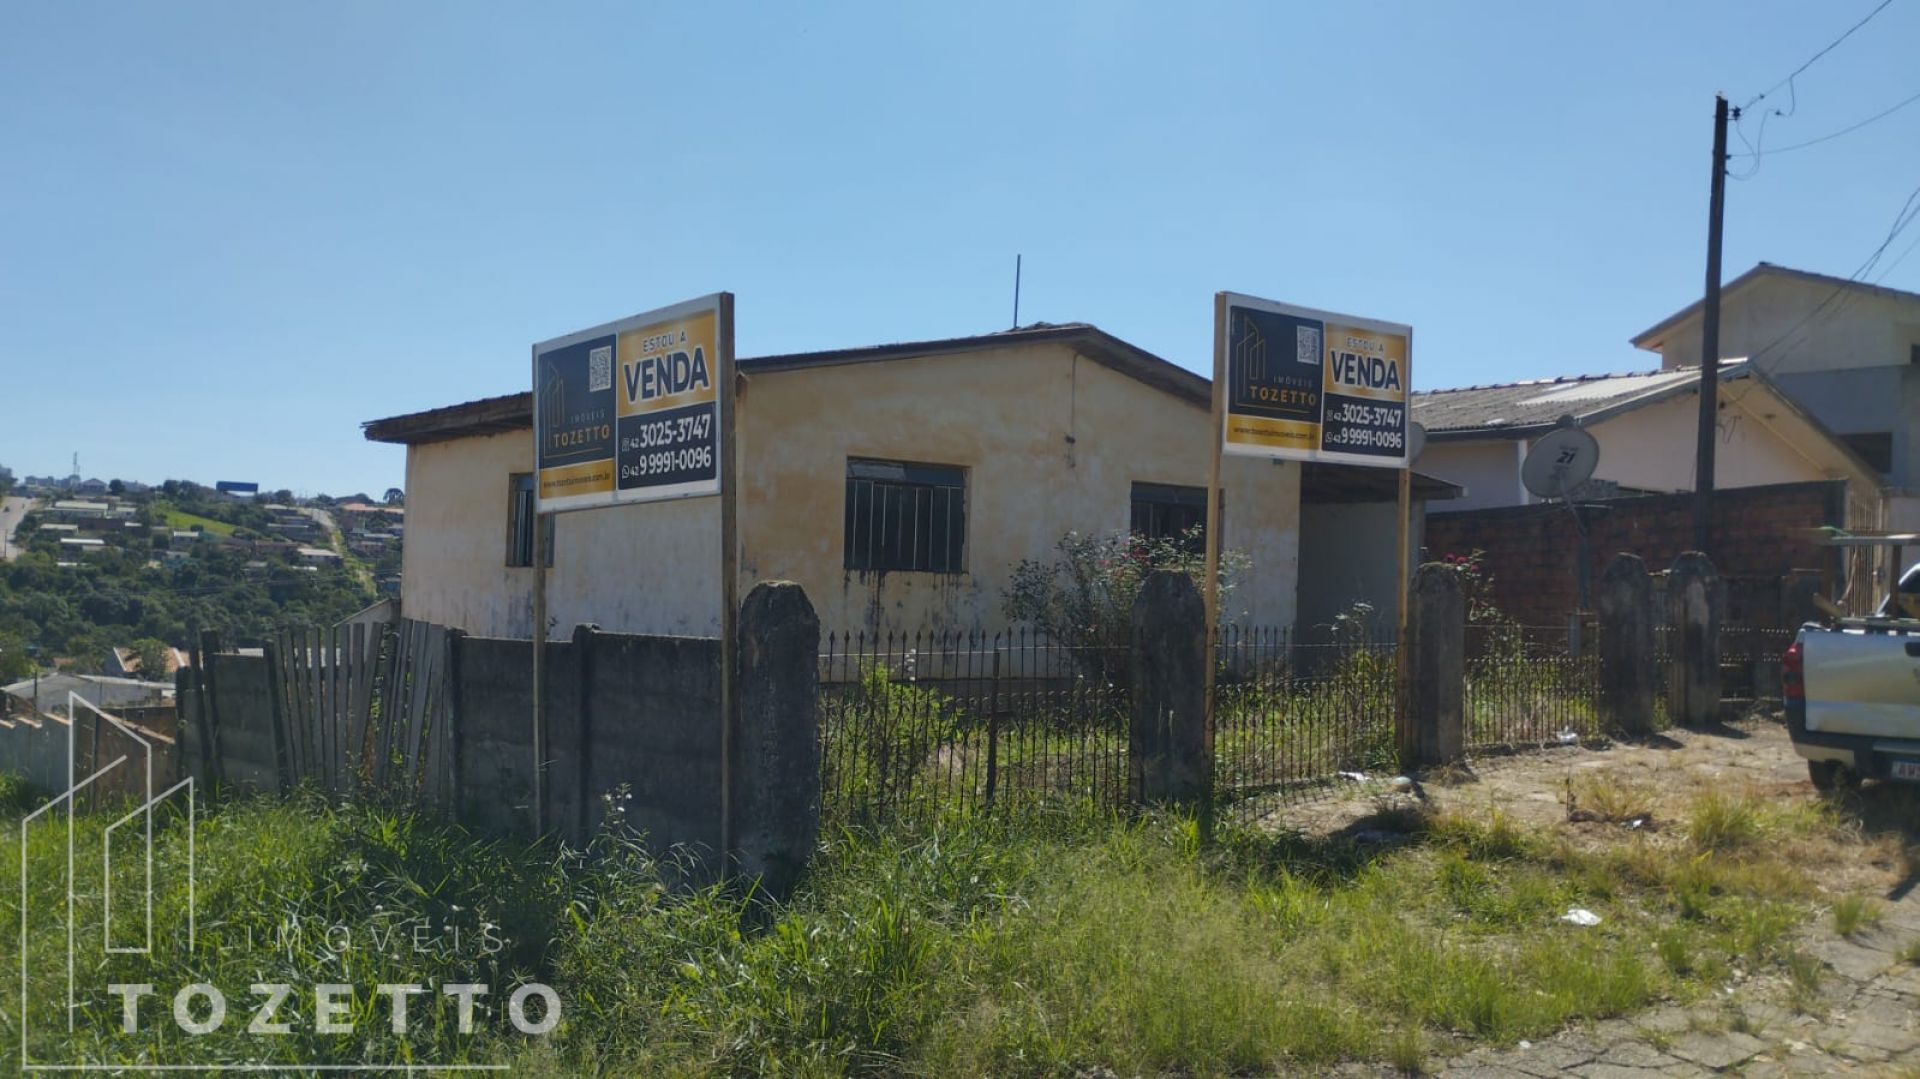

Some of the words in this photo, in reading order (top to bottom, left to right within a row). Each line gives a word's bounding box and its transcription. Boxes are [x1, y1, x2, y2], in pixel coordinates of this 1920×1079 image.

[643, 332, 674, 353] ESTOU
[1346, 337, 1374, 351] ESTOU
[623, 346, 710, 403] VENDA
[1330, 350, 1400, 391] VENDA
[1250, 386, 1317, 406] TOZETTO
[1342, 403, 1402, 428] 3025-3747
[553, 425, 610, 448] TOZETTO
[640, 413, 712, 448] 3025-3747
